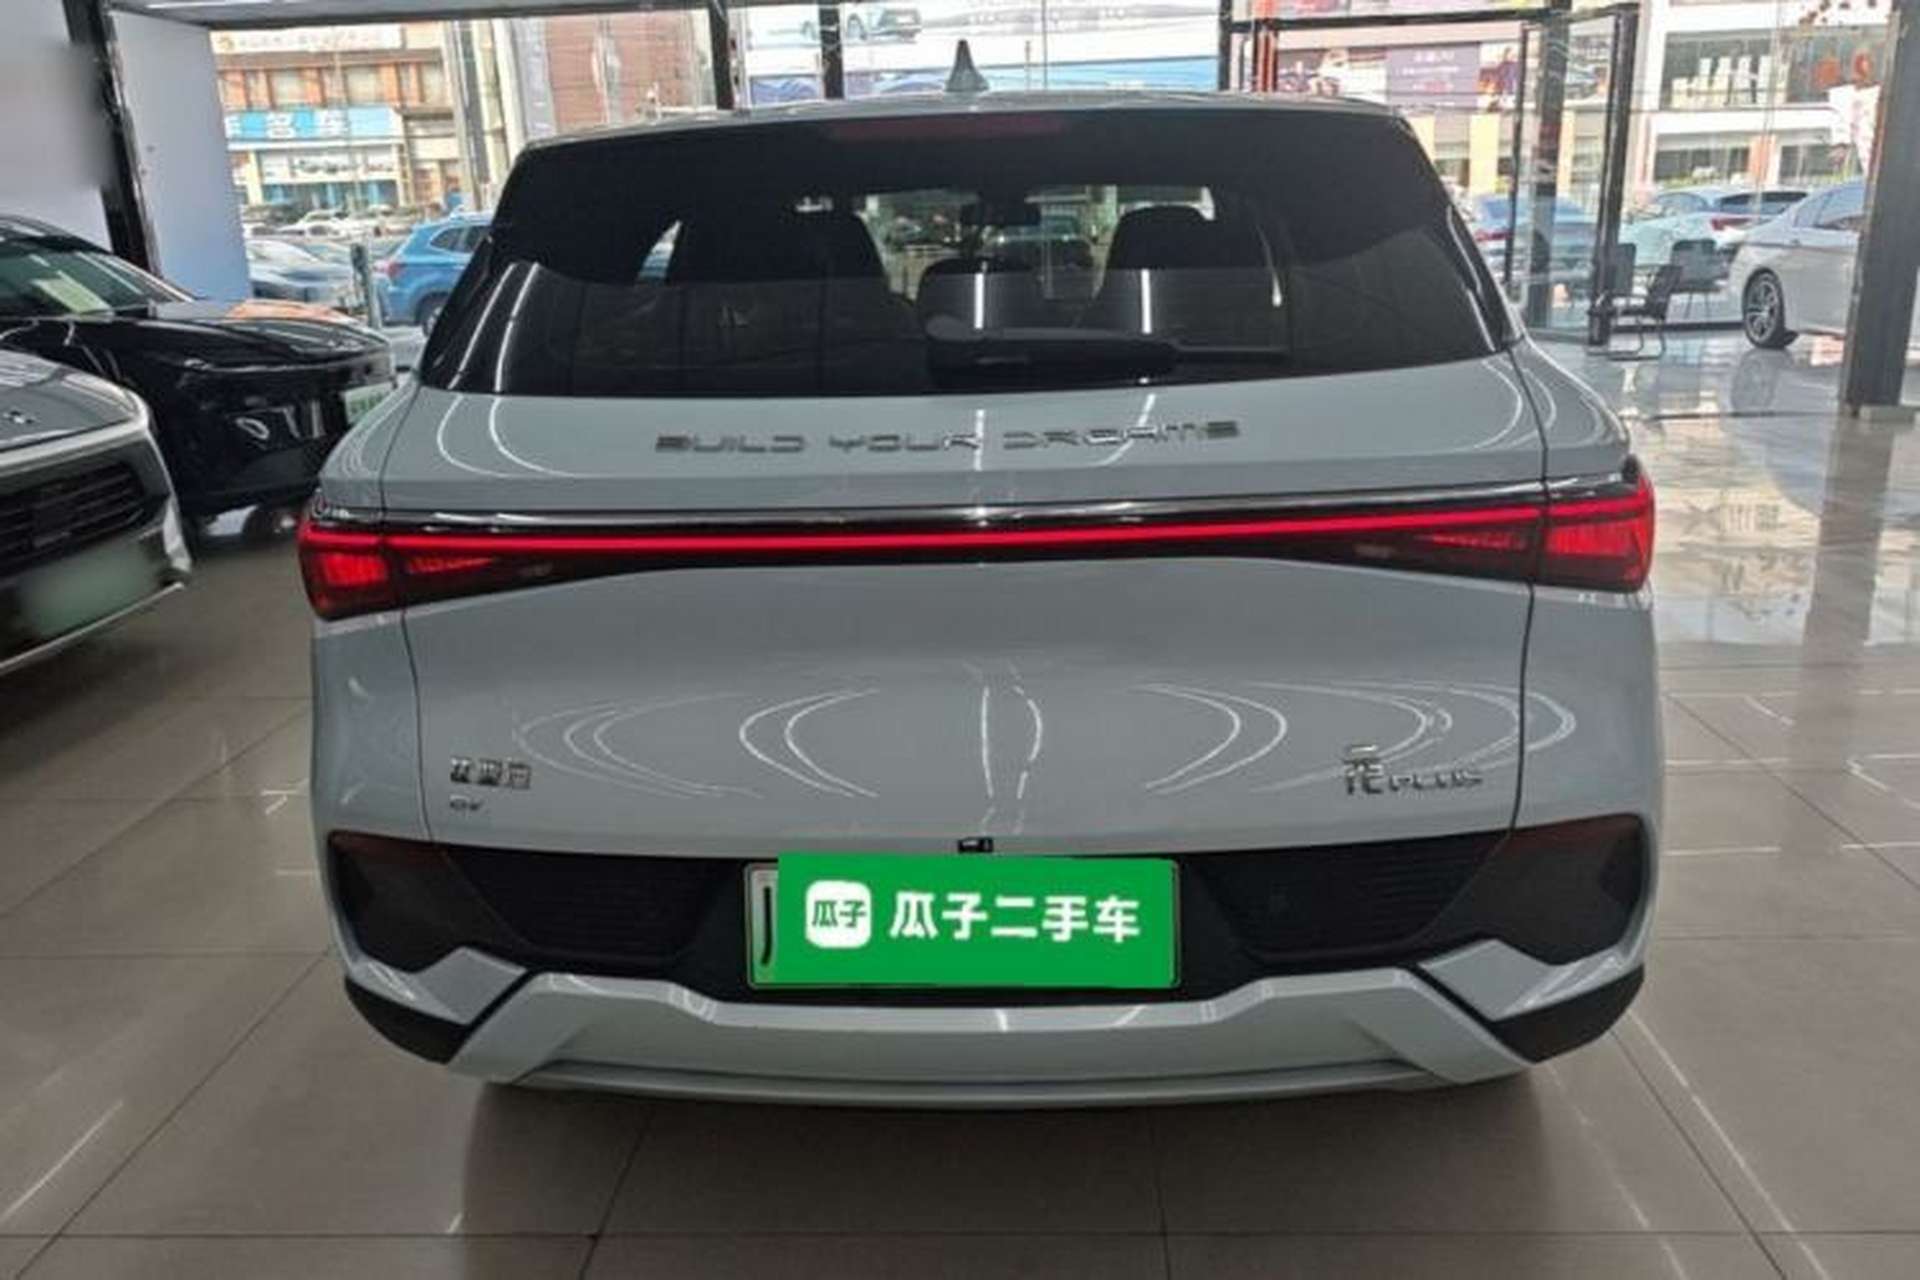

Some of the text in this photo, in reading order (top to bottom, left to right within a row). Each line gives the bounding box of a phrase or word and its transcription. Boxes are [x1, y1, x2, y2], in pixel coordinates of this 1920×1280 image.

[655, 420, 1239, 452] BUILD YOUR DREAMS
